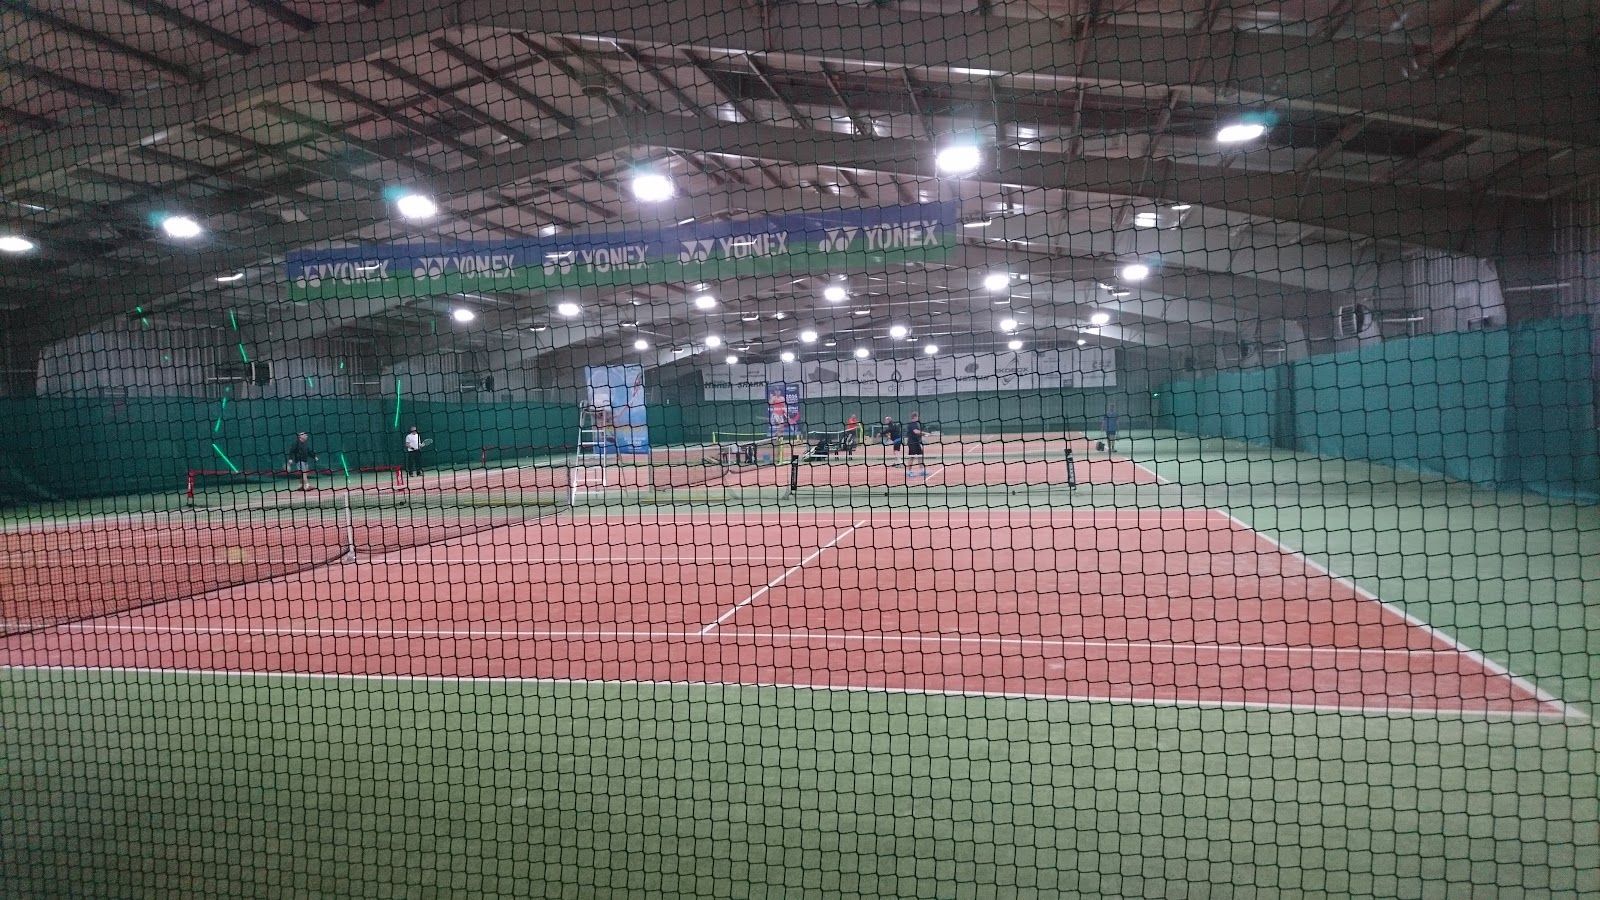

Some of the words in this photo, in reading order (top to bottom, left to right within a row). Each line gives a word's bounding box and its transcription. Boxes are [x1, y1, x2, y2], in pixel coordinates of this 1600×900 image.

[718, 231, 790, 261] YONEX
[864, 219, 938, 250] YONEX
[453, 254, 516, 280] YONEX
[580, 245, 650, 273] YONEX
